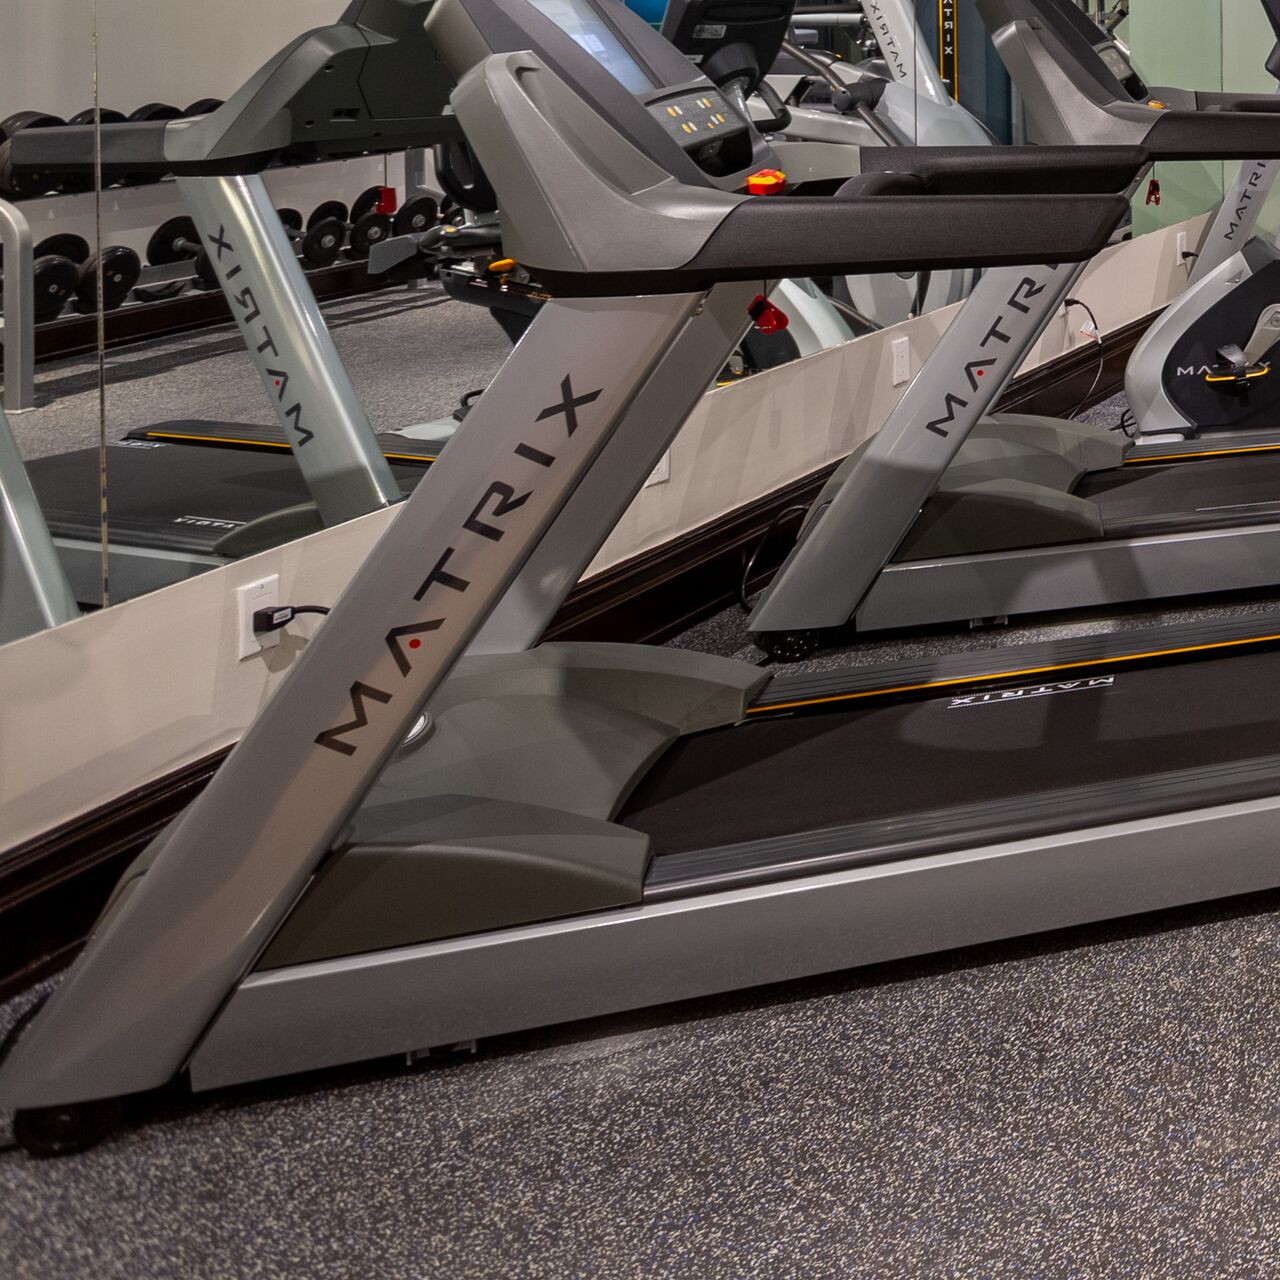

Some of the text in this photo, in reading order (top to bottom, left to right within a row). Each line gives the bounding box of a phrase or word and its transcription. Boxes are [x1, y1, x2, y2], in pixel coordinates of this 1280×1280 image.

[1223, 160, 1268, 241] MATRI
[925, 263, 1059, 438] MATR
[314, 372, 604, 757] MATRIX
[950, 676, 1116, 706] MATRIX
